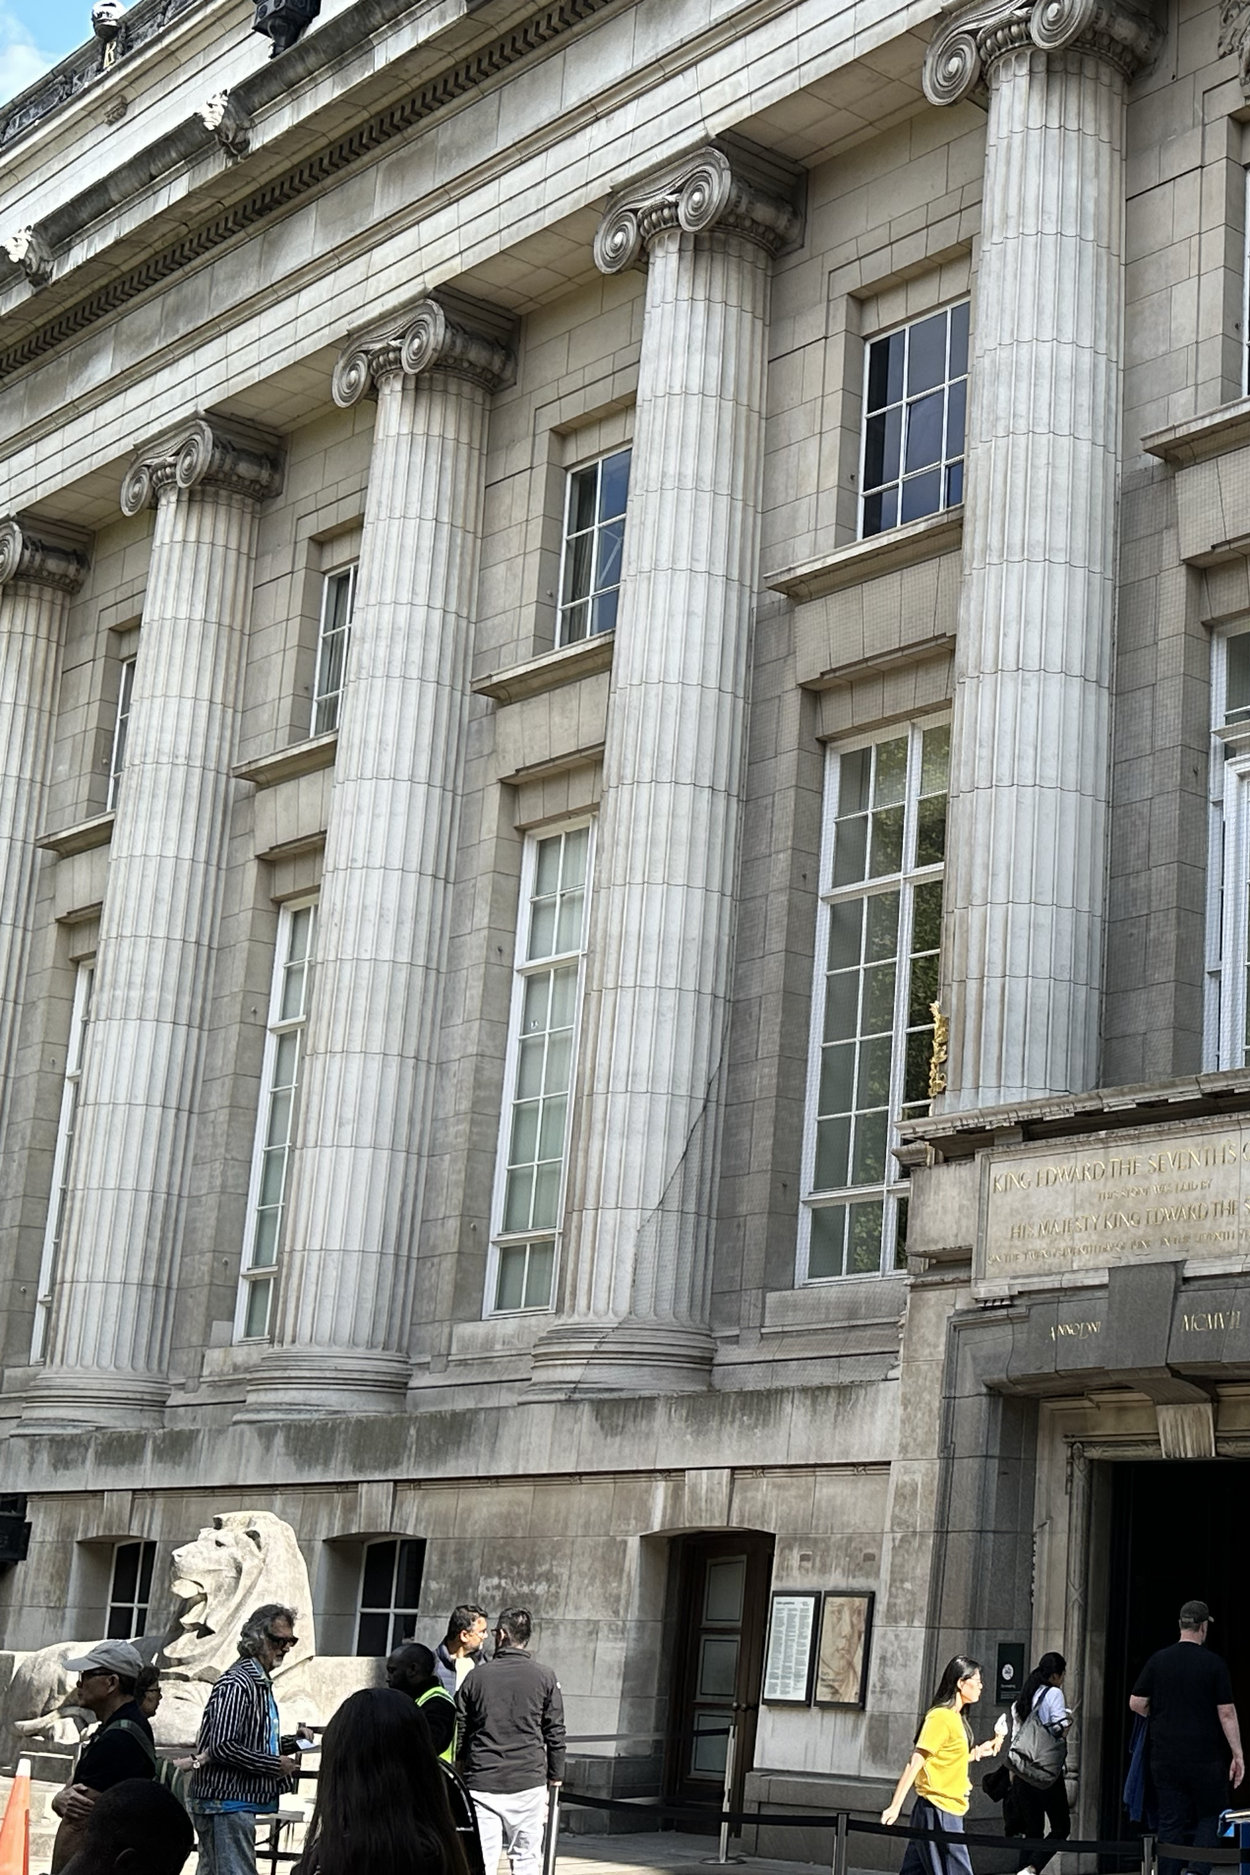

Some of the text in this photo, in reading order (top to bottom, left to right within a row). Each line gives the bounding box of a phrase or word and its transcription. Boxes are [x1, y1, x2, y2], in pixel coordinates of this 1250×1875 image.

[992, 1170, 1032, 1194] KING
[1036, 1160, 1105, 1188] EDWARD
[1110, 1155, 1142, 1178] THE
[1175, 1179, 1199, 1194] LAID
[1200, 1178, 1213, 1191] BY
[1010, 1222, 1034, 1241] HIS
[1037, 1214, 1099, 1239] MAJESTY
[1103, 1211, 1142, 1231] KING
[1146, 1202, 1209, 1226] EDWARD
[1212, 1199, 1238, 1219] THE
